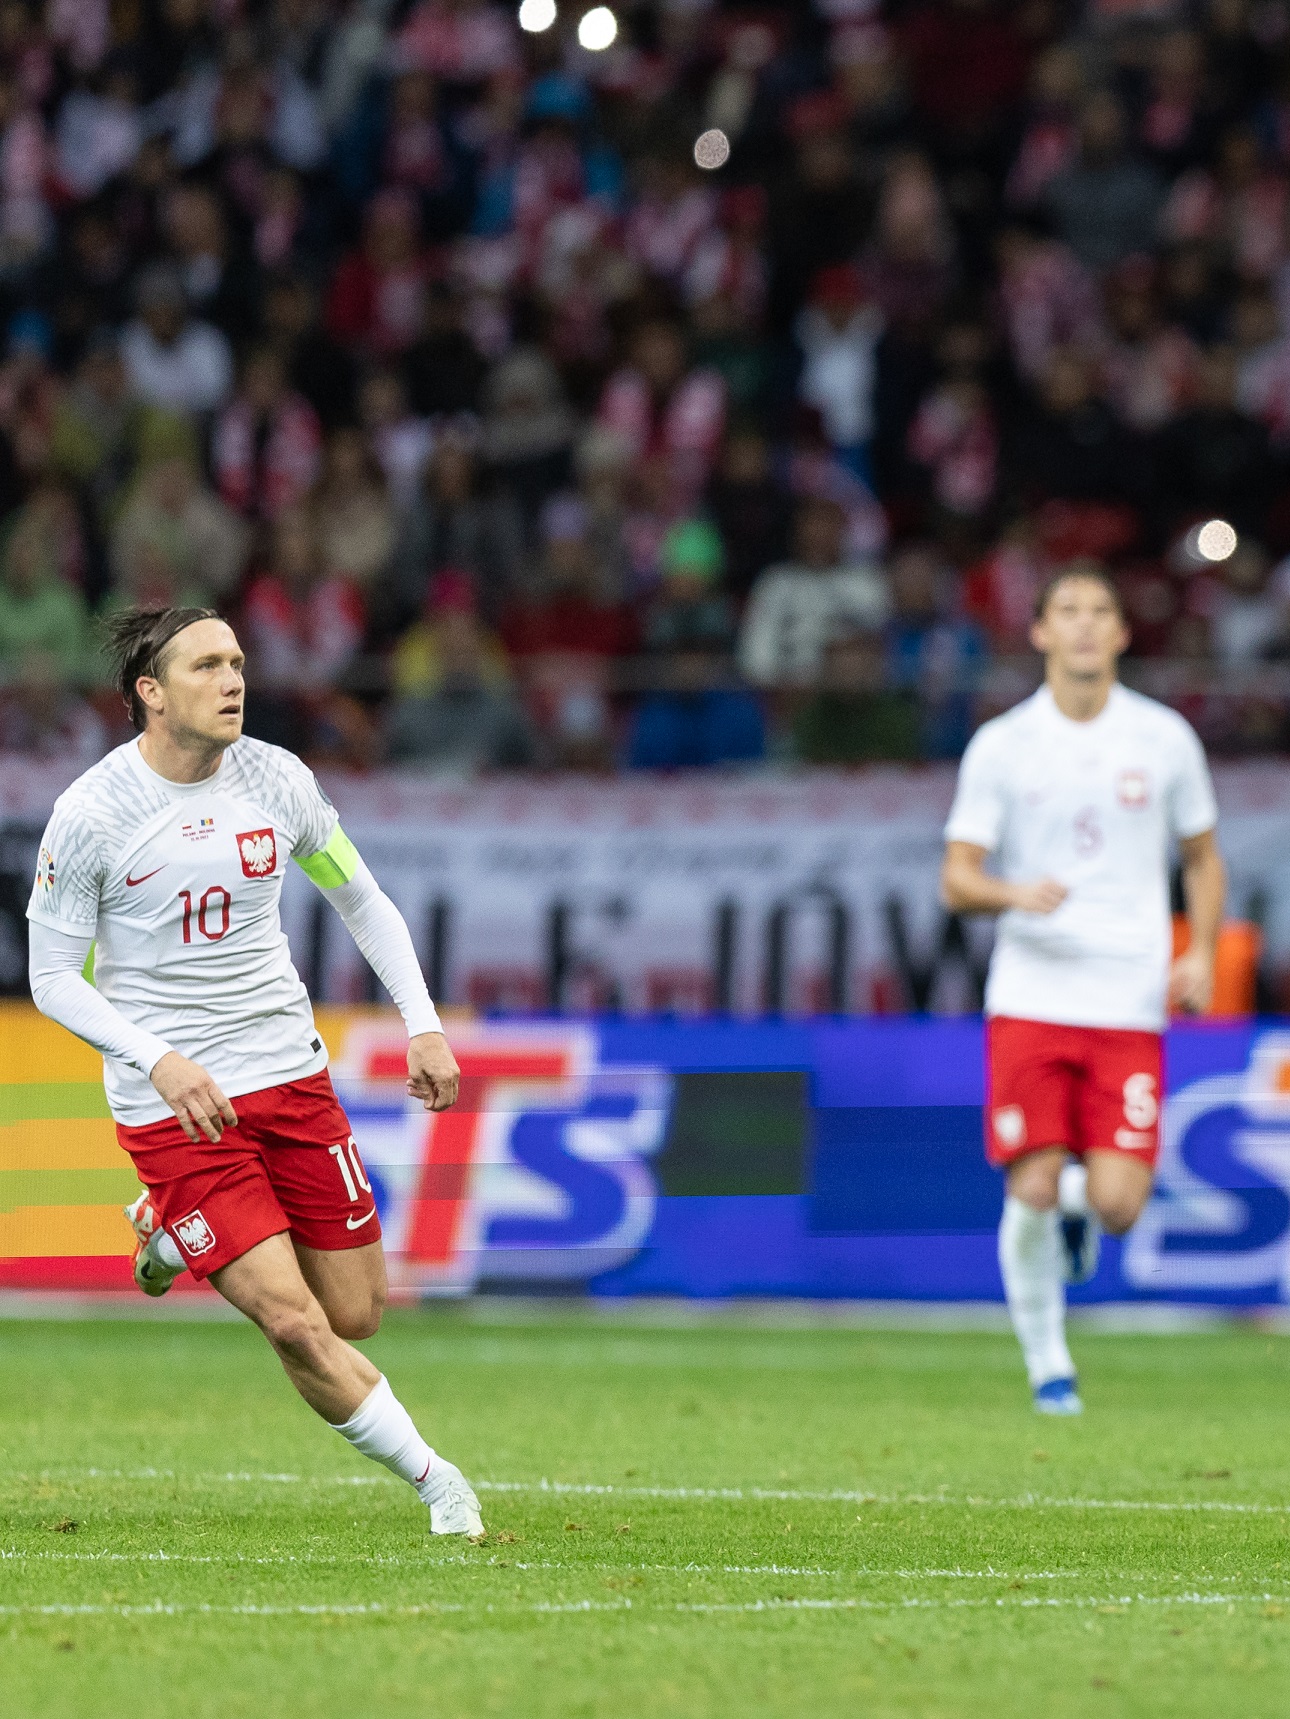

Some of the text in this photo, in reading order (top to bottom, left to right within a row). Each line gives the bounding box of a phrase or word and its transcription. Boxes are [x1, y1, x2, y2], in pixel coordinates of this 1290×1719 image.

[178, 885, 232, 943] 10
[328, 1135, 372, 1202] 10
[338, 1022, 663, 1295] TS
